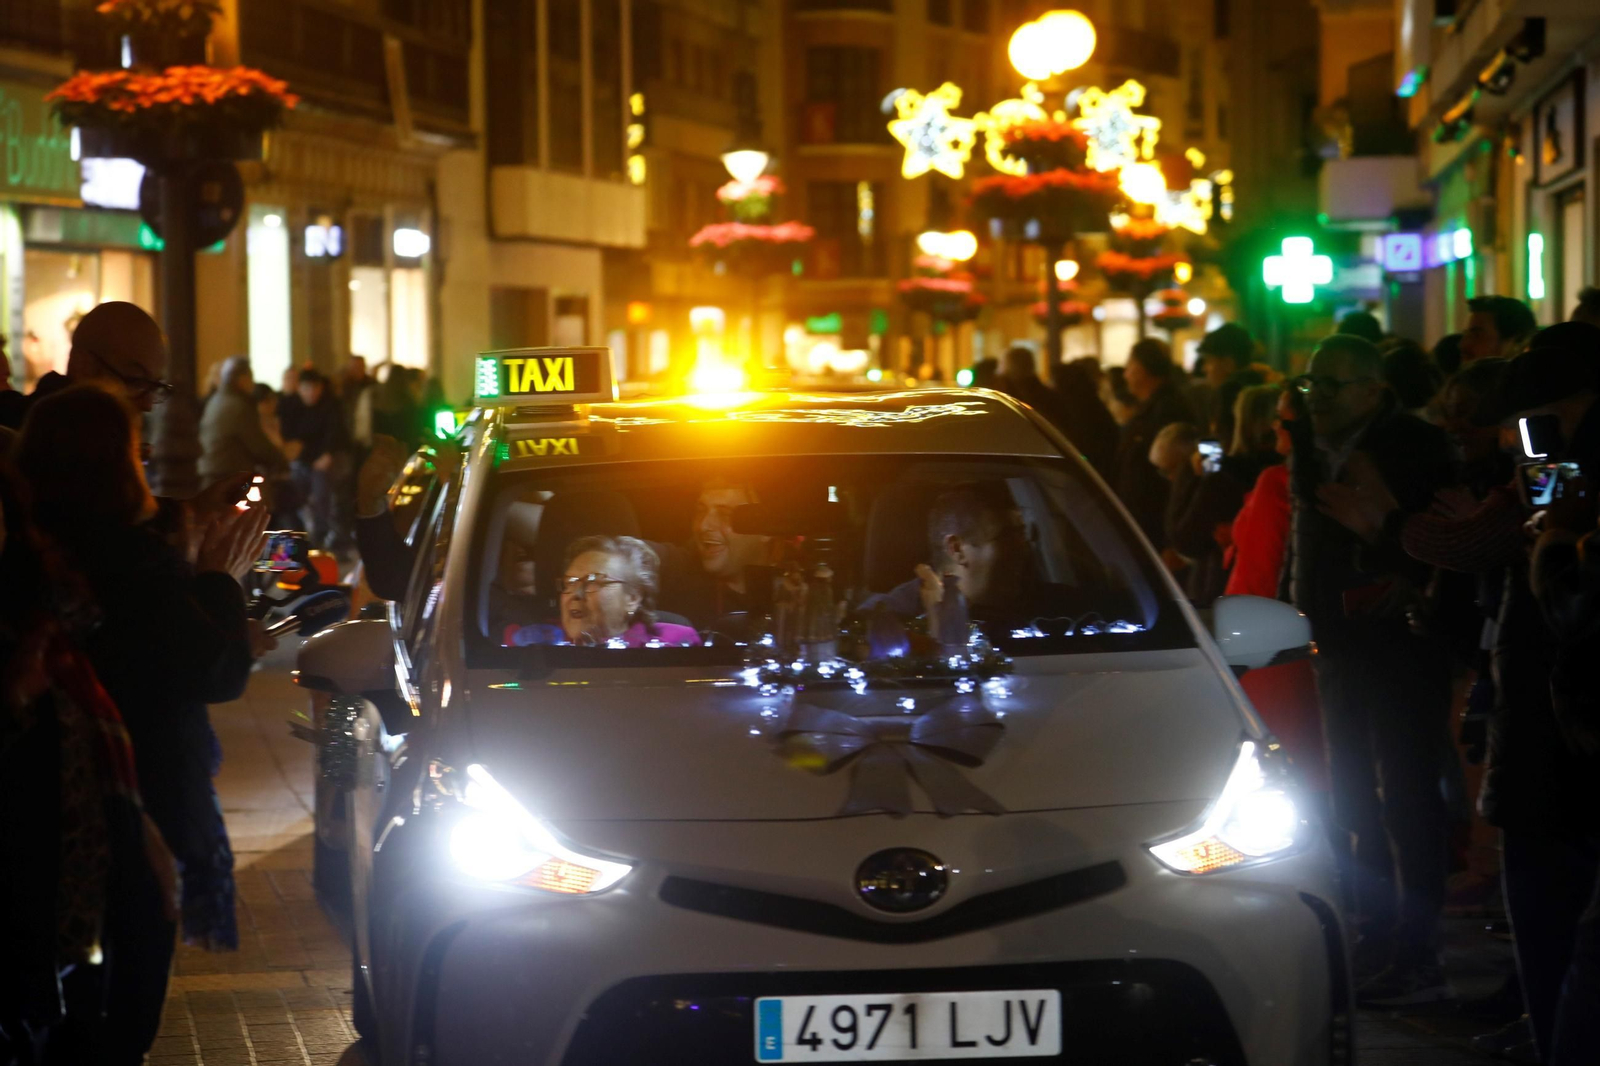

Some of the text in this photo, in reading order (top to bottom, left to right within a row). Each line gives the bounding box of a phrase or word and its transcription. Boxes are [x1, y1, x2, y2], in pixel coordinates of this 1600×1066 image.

[503, 357, 575, 393] TAXI
[796, 999, 1046, 1051] 4971 LJV
